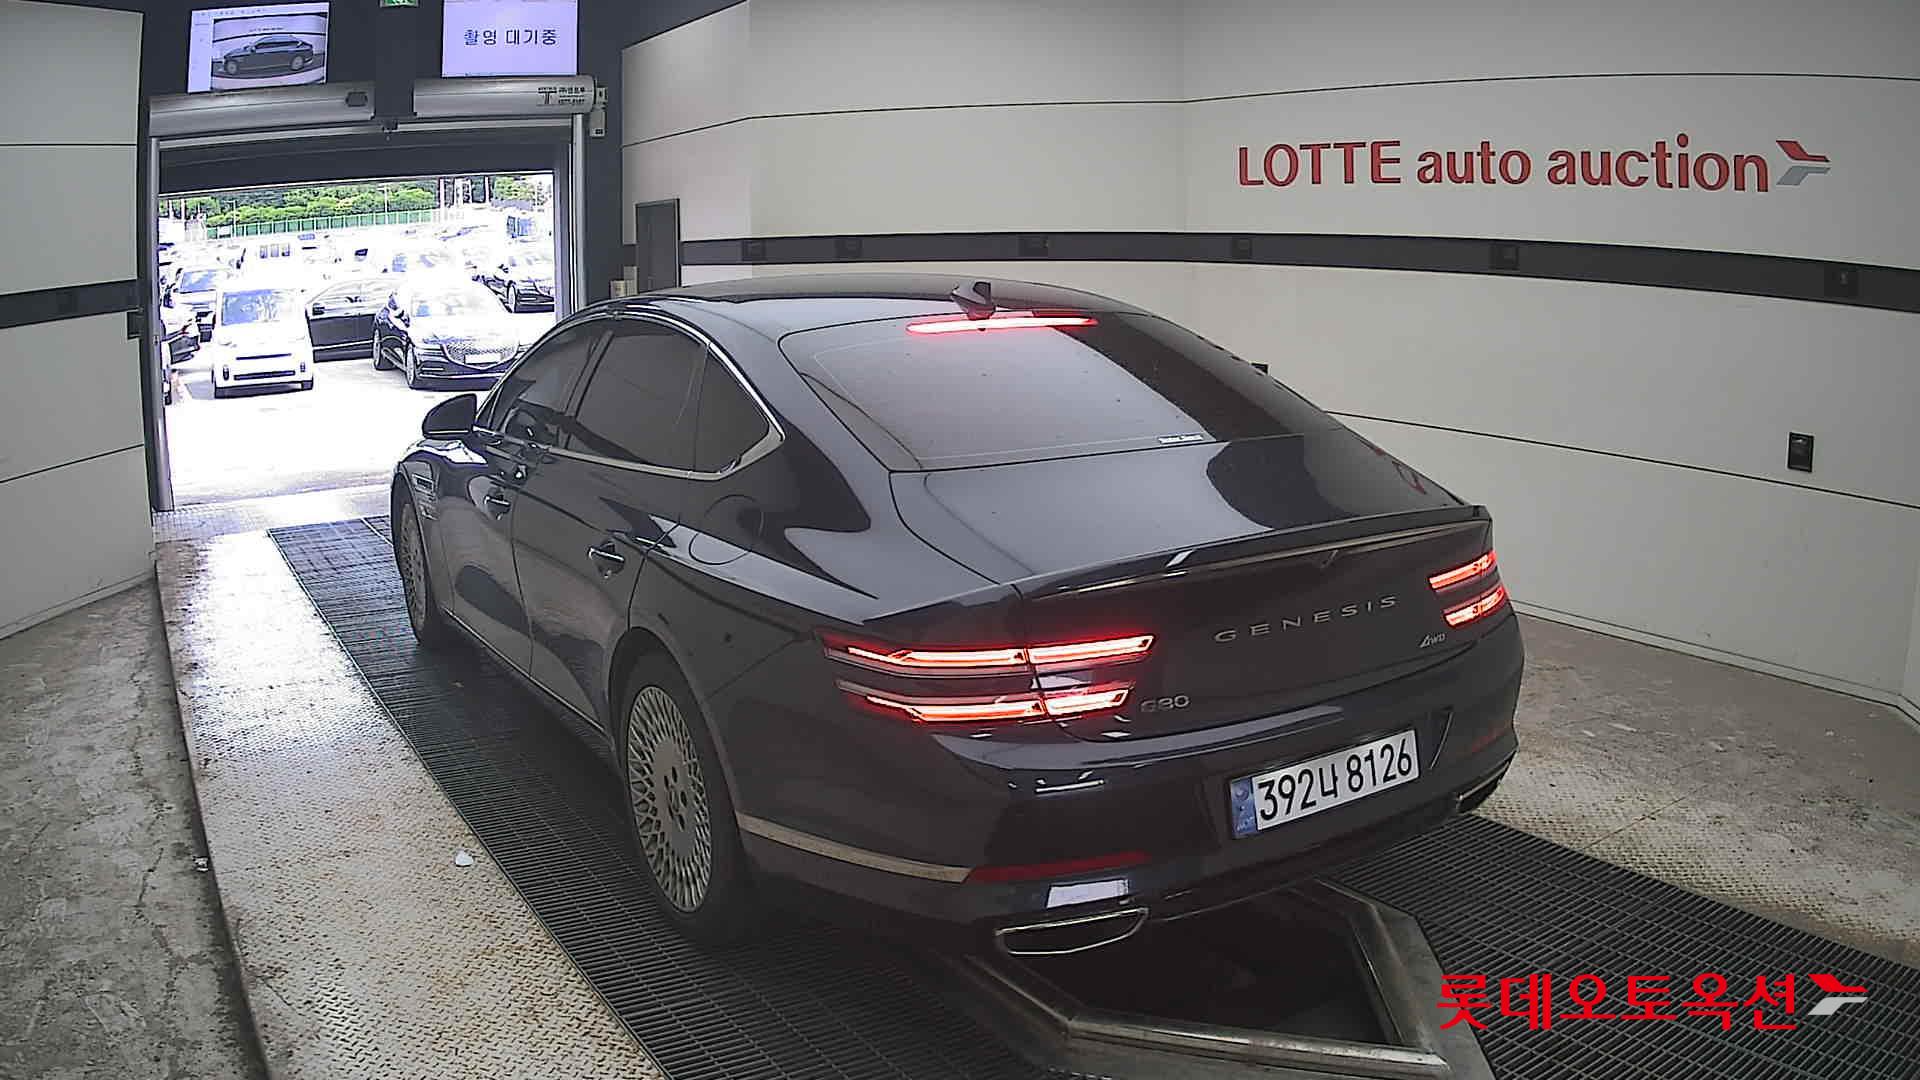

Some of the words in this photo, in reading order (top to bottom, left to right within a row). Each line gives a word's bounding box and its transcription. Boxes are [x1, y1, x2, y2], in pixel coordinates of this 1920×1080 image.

[505, 29, 557, 46] 대기중
[1239, 139, 1401, 187] LOTTE
[1416, 140, 1532, 185] auto
[1546, 132, 1770, 193] auction
[1214, 595, 1397, 643] GENESIS
[1257, 764, 1339, 821] 392나
[1346, 738, 1412, 793] 8126
